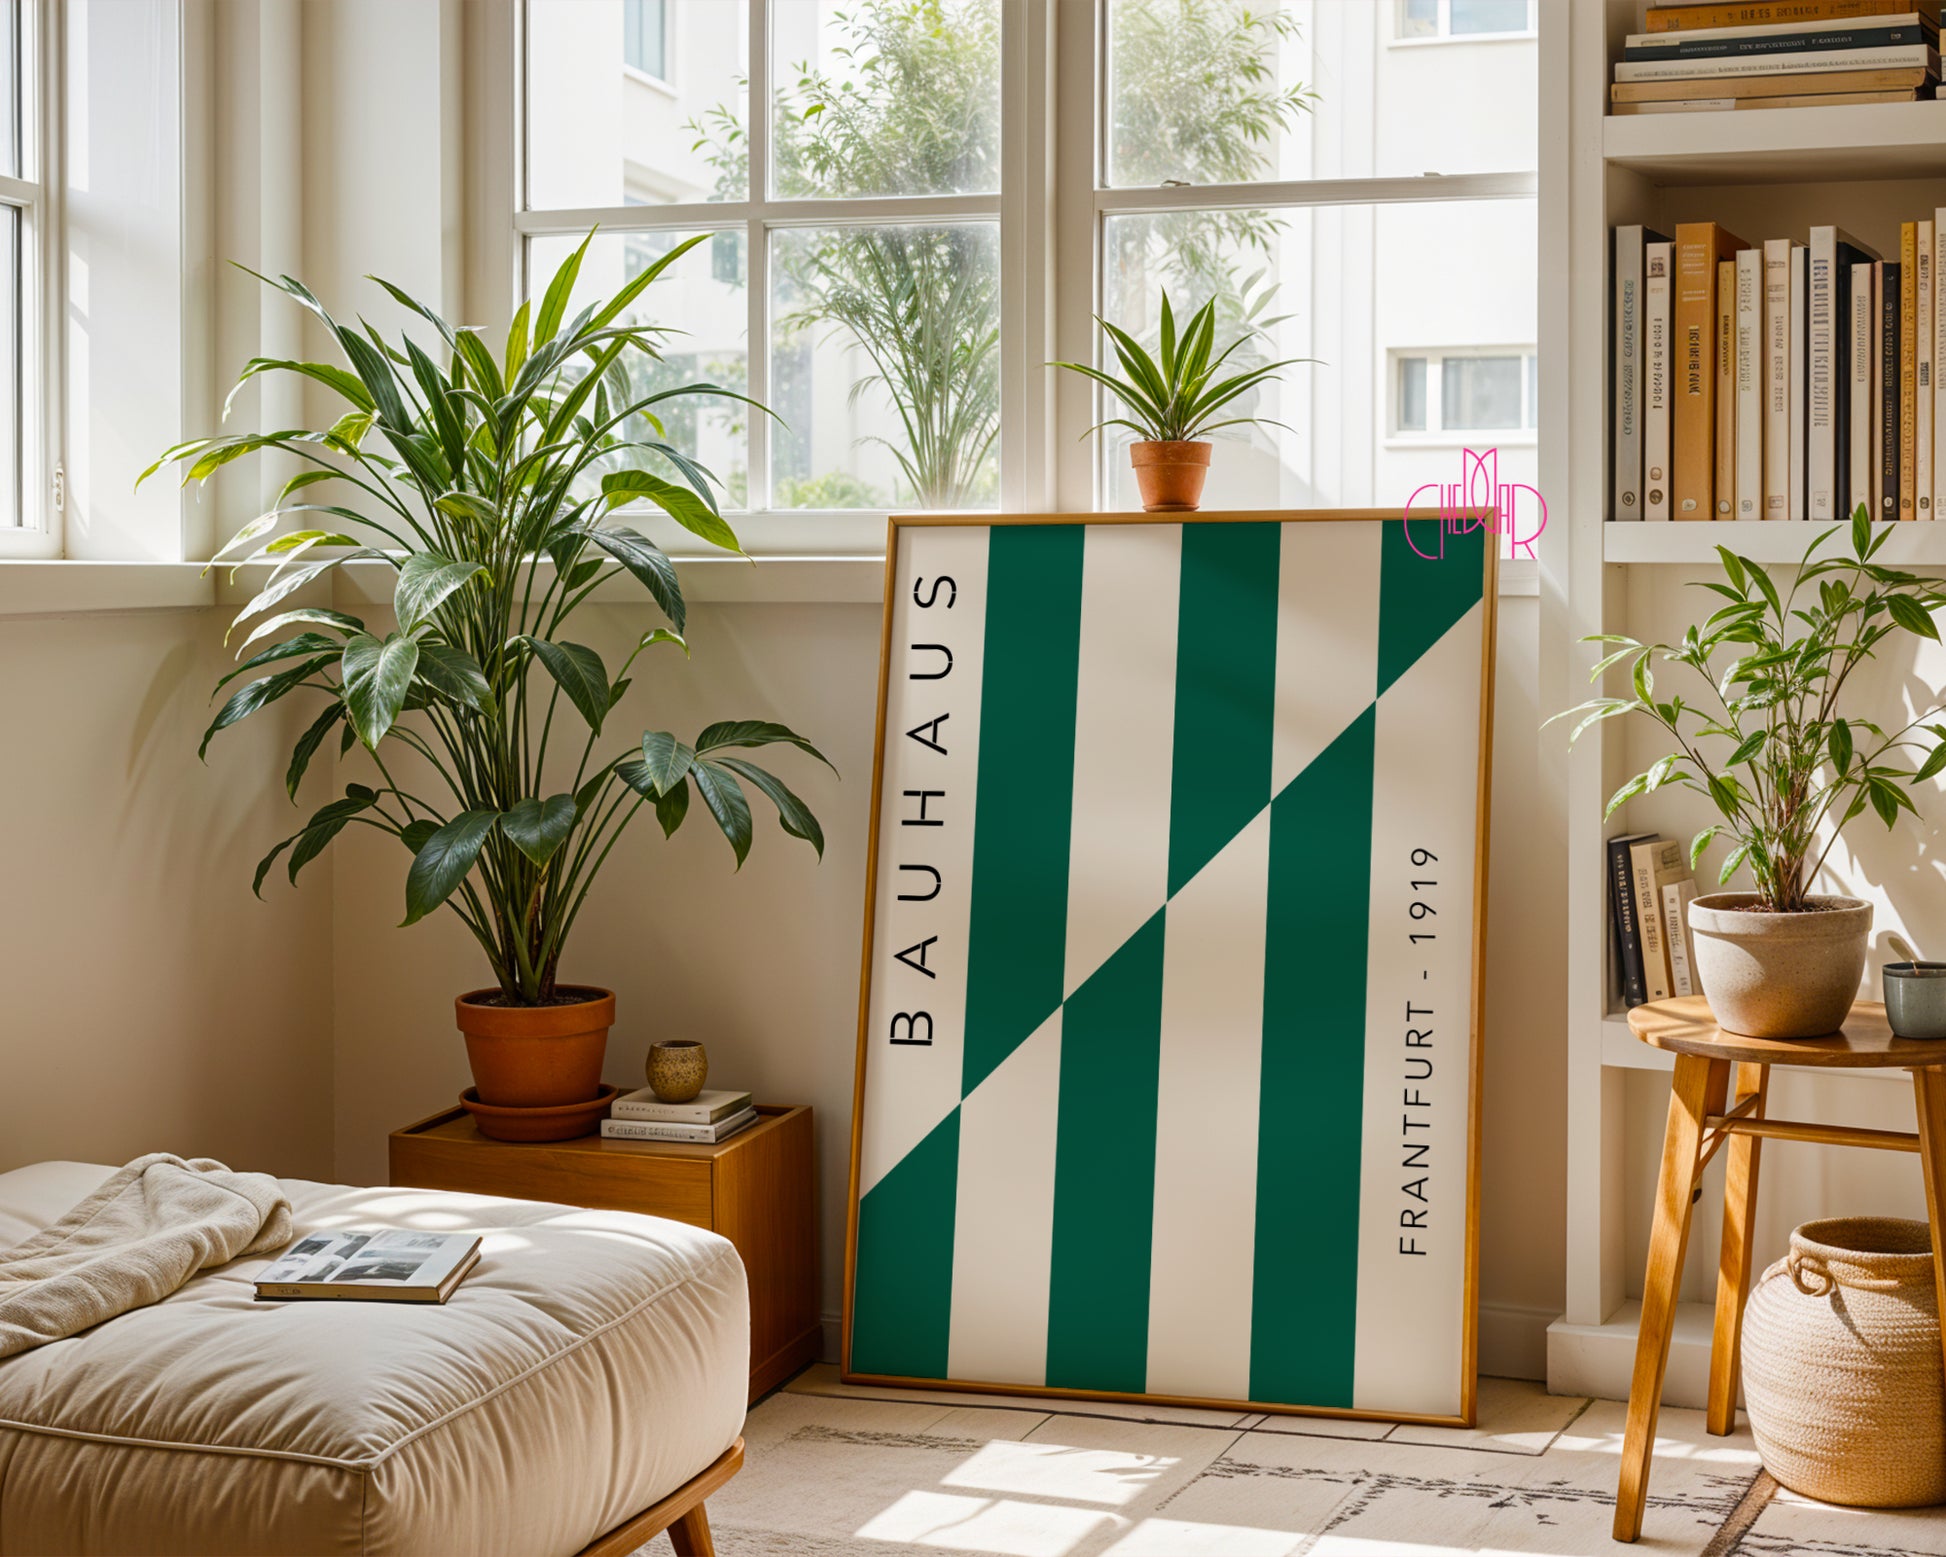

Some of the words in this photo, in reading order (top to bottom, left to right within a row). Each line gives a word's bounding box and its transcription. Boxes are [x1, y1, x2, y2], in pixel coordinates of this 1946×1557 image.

[888, 573, 958, 1048] BAUHAUS
[1408, 848, 1439, 945] 1919
[1399, 1000, 1434, 1256] FRANTFURT
